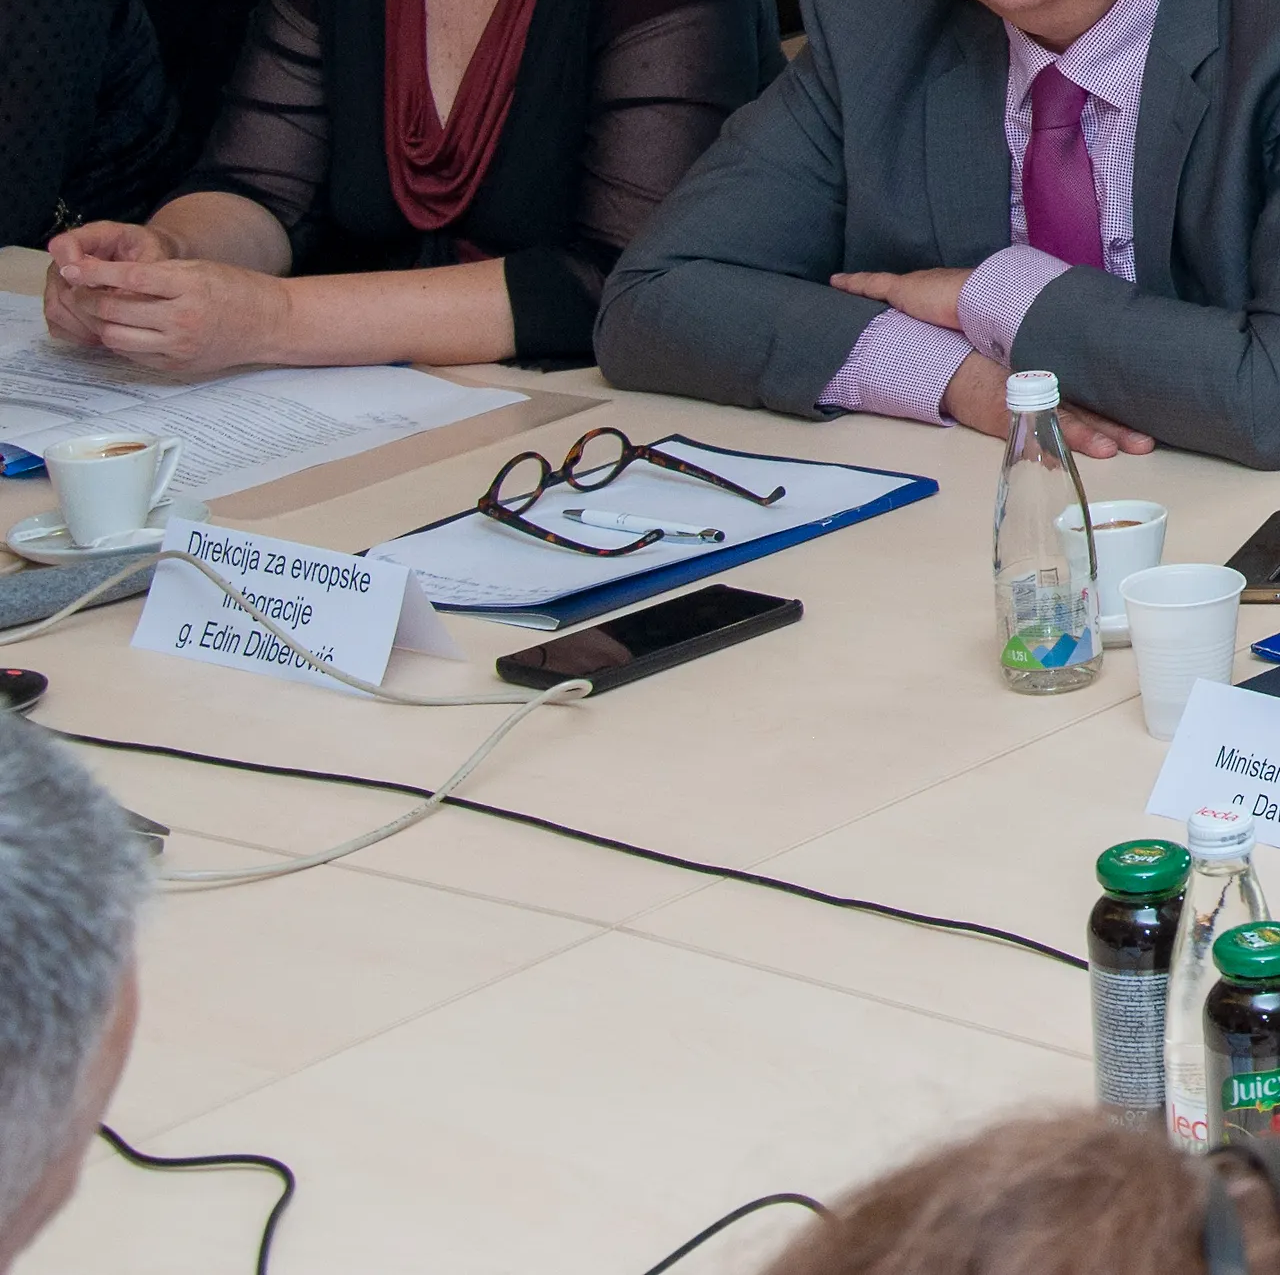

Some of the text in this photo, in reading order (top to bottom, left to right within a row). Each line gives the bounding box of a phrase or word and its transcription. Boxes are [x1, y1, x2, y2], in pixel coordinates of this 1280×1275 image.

[187, 530, 260, 575] Direkcija
[264, 552, 287, 576] za
[291, 559, 371, 593] evropske
[175, 622, 193, 649] g.
[199, 620, 241, 653] Edin
[1195, 806, 1239, 821] leda
